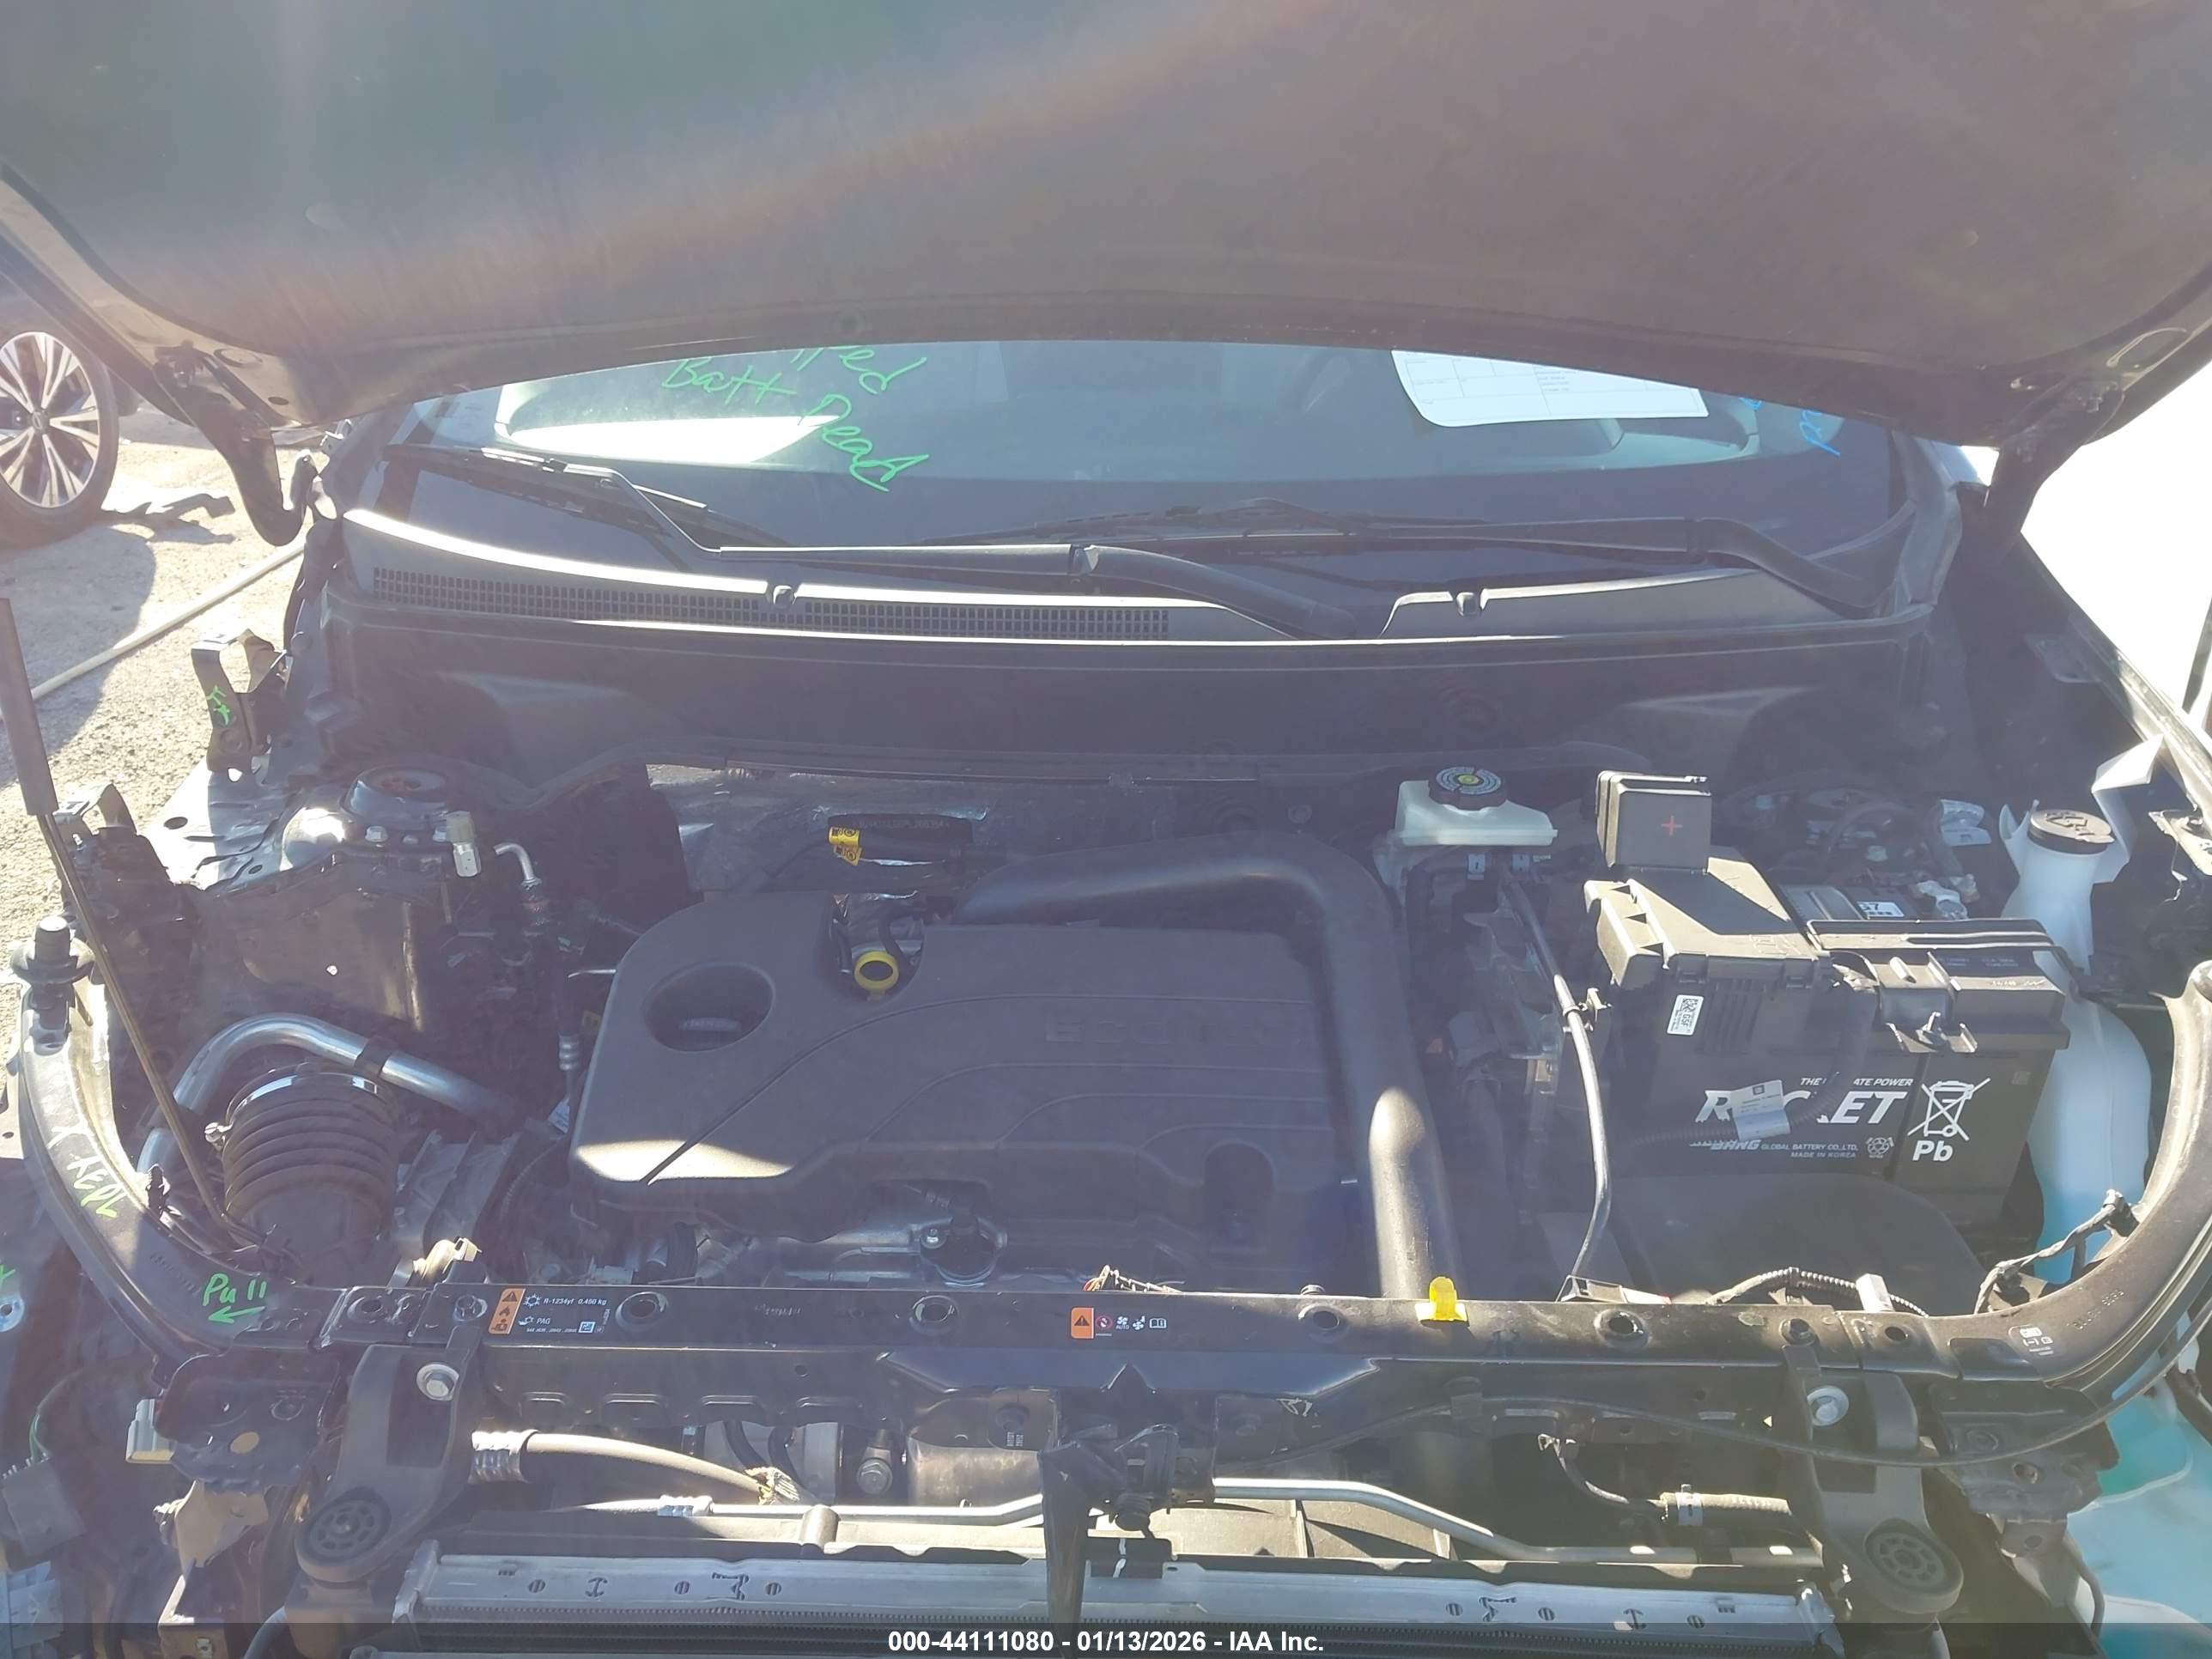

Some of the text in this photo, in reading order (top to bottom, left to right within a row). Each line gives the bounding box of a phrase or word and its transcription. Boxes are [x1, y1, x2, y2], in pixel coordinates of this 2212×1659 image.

[797, 394, 930, 492] Dead
[1800, 1078, 1822, 1086] THE
[1873, 1078, 1914, 1086] POWER
[1913, 1140, 1954, 1162] Pb
[203, 1273, 267, 1306] Pull
